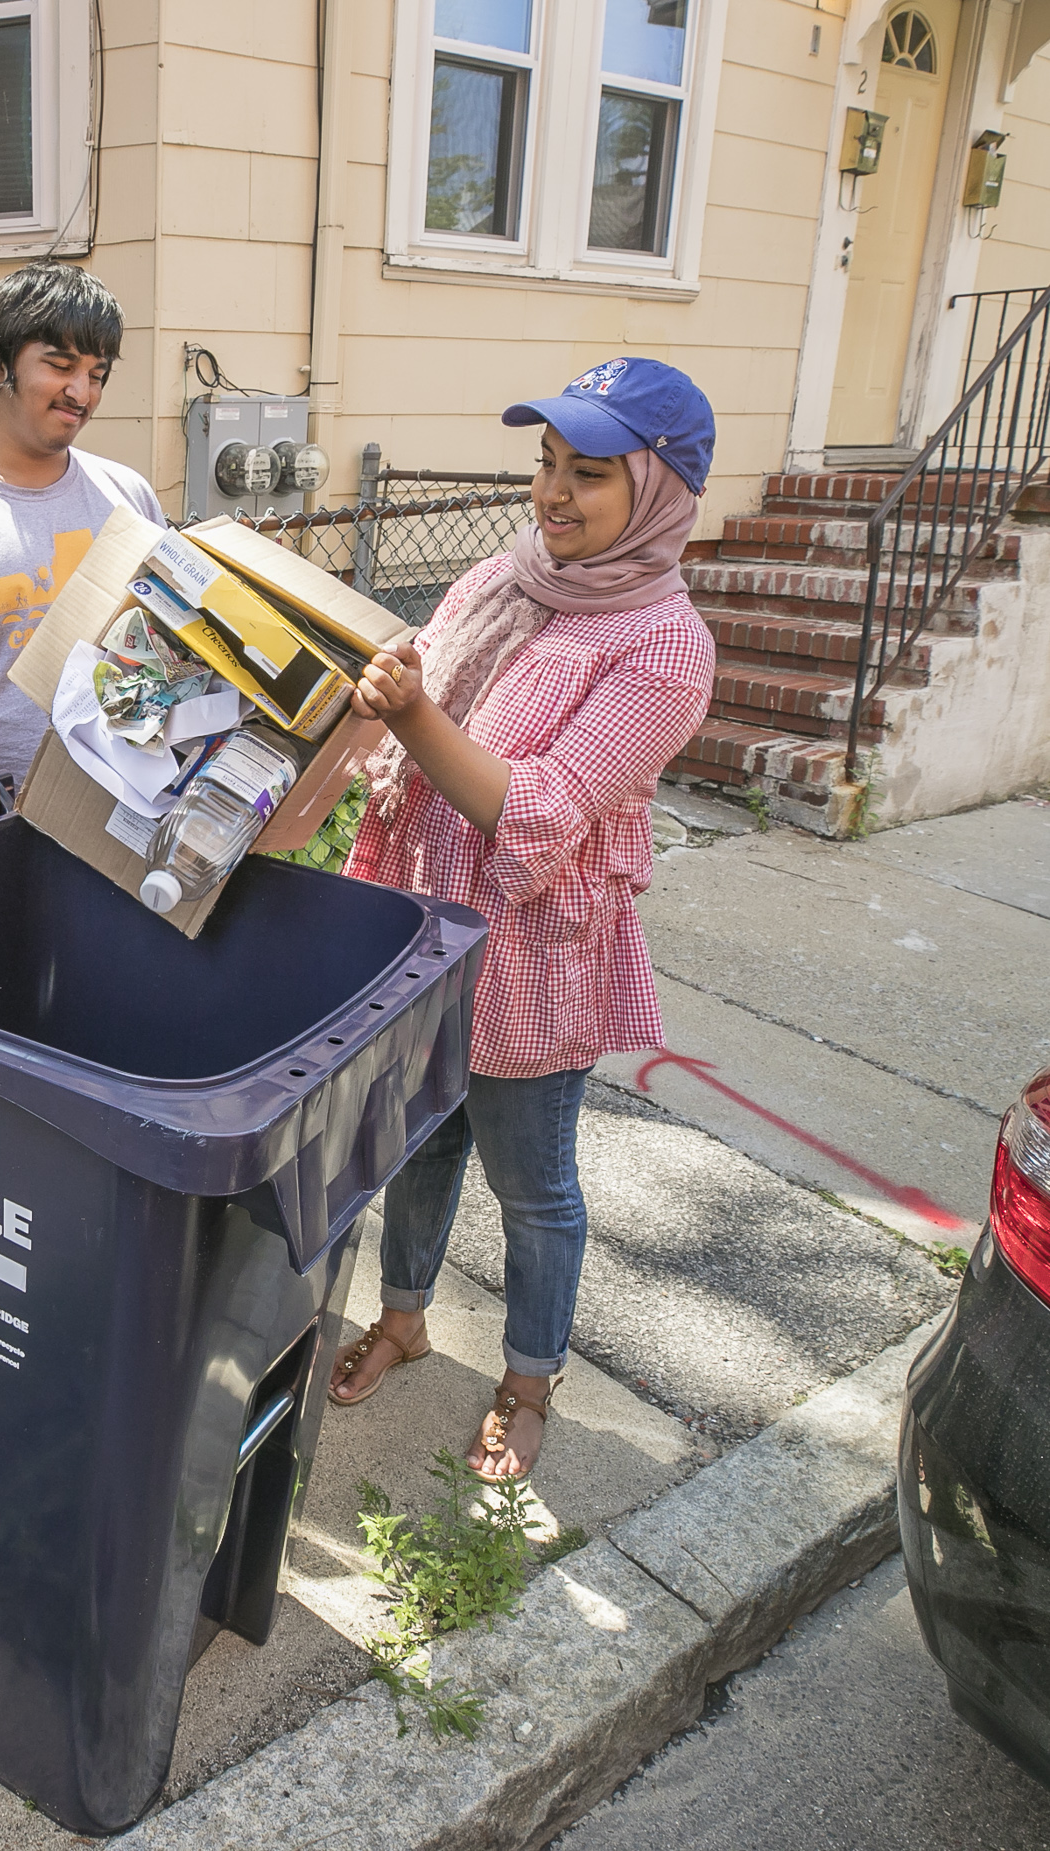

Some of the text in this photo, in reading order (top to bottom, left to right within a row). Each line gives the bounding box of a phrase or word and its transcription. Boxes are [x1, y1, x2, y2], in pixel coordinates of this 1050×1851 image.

[857, 70, 868, 94] 2
[159, 541, 208, 587] WHOLE GRAIN
[165, 534, 214, 577] FIRST INGREDIENT
[202, 626, 238, 668] Cheerios
